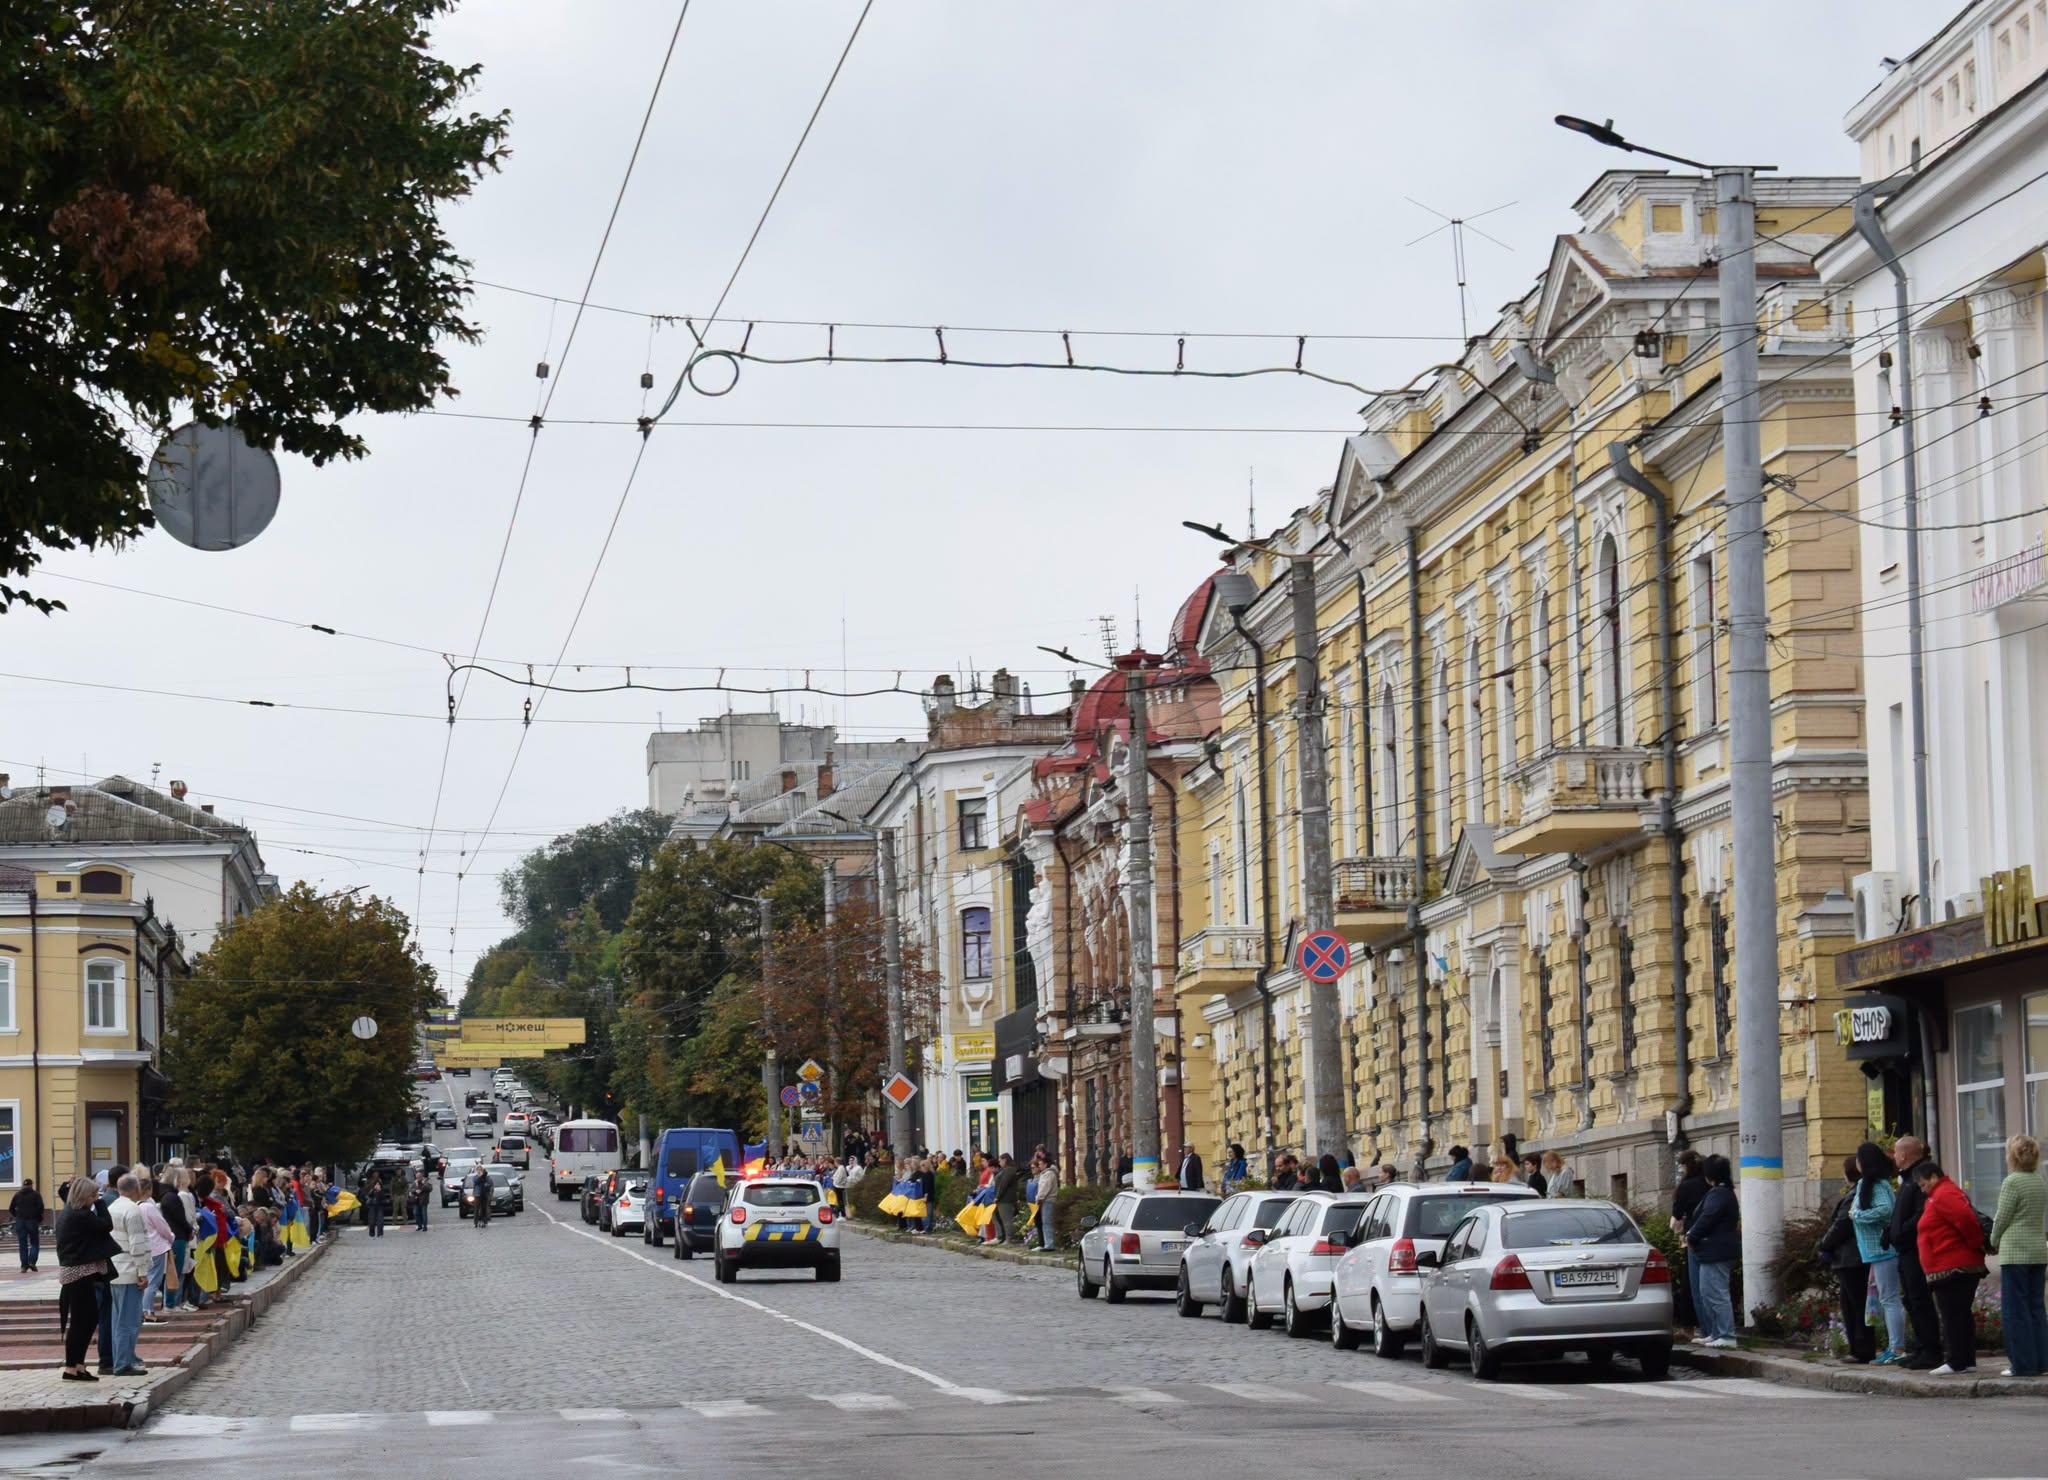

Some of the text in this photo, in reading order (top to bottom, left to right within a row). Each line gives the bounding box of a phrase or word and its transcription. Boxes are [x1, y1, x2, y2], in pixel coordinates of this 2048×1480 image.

[1853, 1010, 1885, 1037] SHOP
[1561, 1271, 1616, 1283] BA 5972 HH
